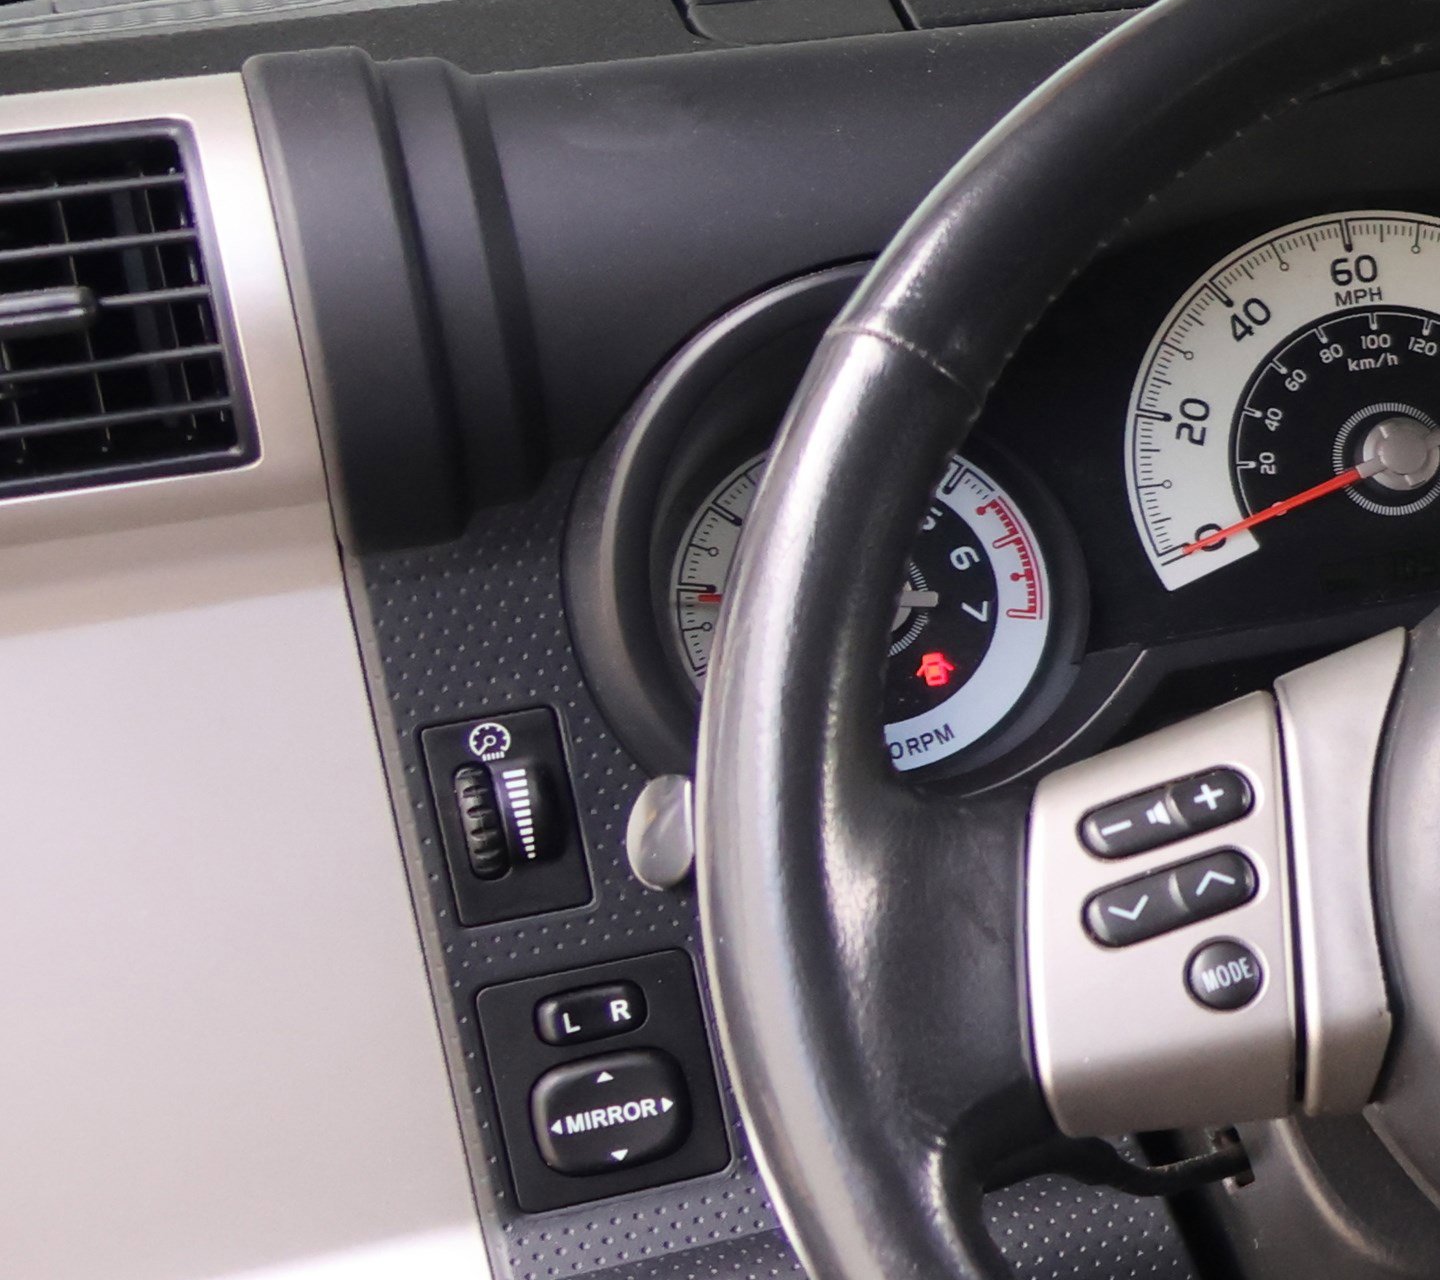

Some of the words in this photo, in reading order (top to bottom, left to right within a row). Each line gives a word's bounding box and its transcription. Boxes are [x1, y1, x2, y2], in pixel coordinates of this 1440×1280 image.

[1330, 254, 1378, 287] 60
[1334, 286, 1383, 307] MPH
[1228, 297, 1272, 343] 40
[1319, 343, 1344, 364] 80
[1360, 333, 1392, 349] 100
[1406, 336, 1438, 357] 120
[1347, 352, 1399, 372] km/h
[1284, 368, 1308, 393] 60
[1175, 397, 1211, 447] 20
[1265, 407, 1283, 432] 40
[1259, 451, 1277, 475] 20
[950, 545, 980, 571] 6
[961, 600, 990, 622] 7
[1201, 956, 1253, 994] MODE
[562, 1012, 581, 1034] L
[610, 999, 632, 1023] R
[565, 1097, 659, 1135] MIRROR
